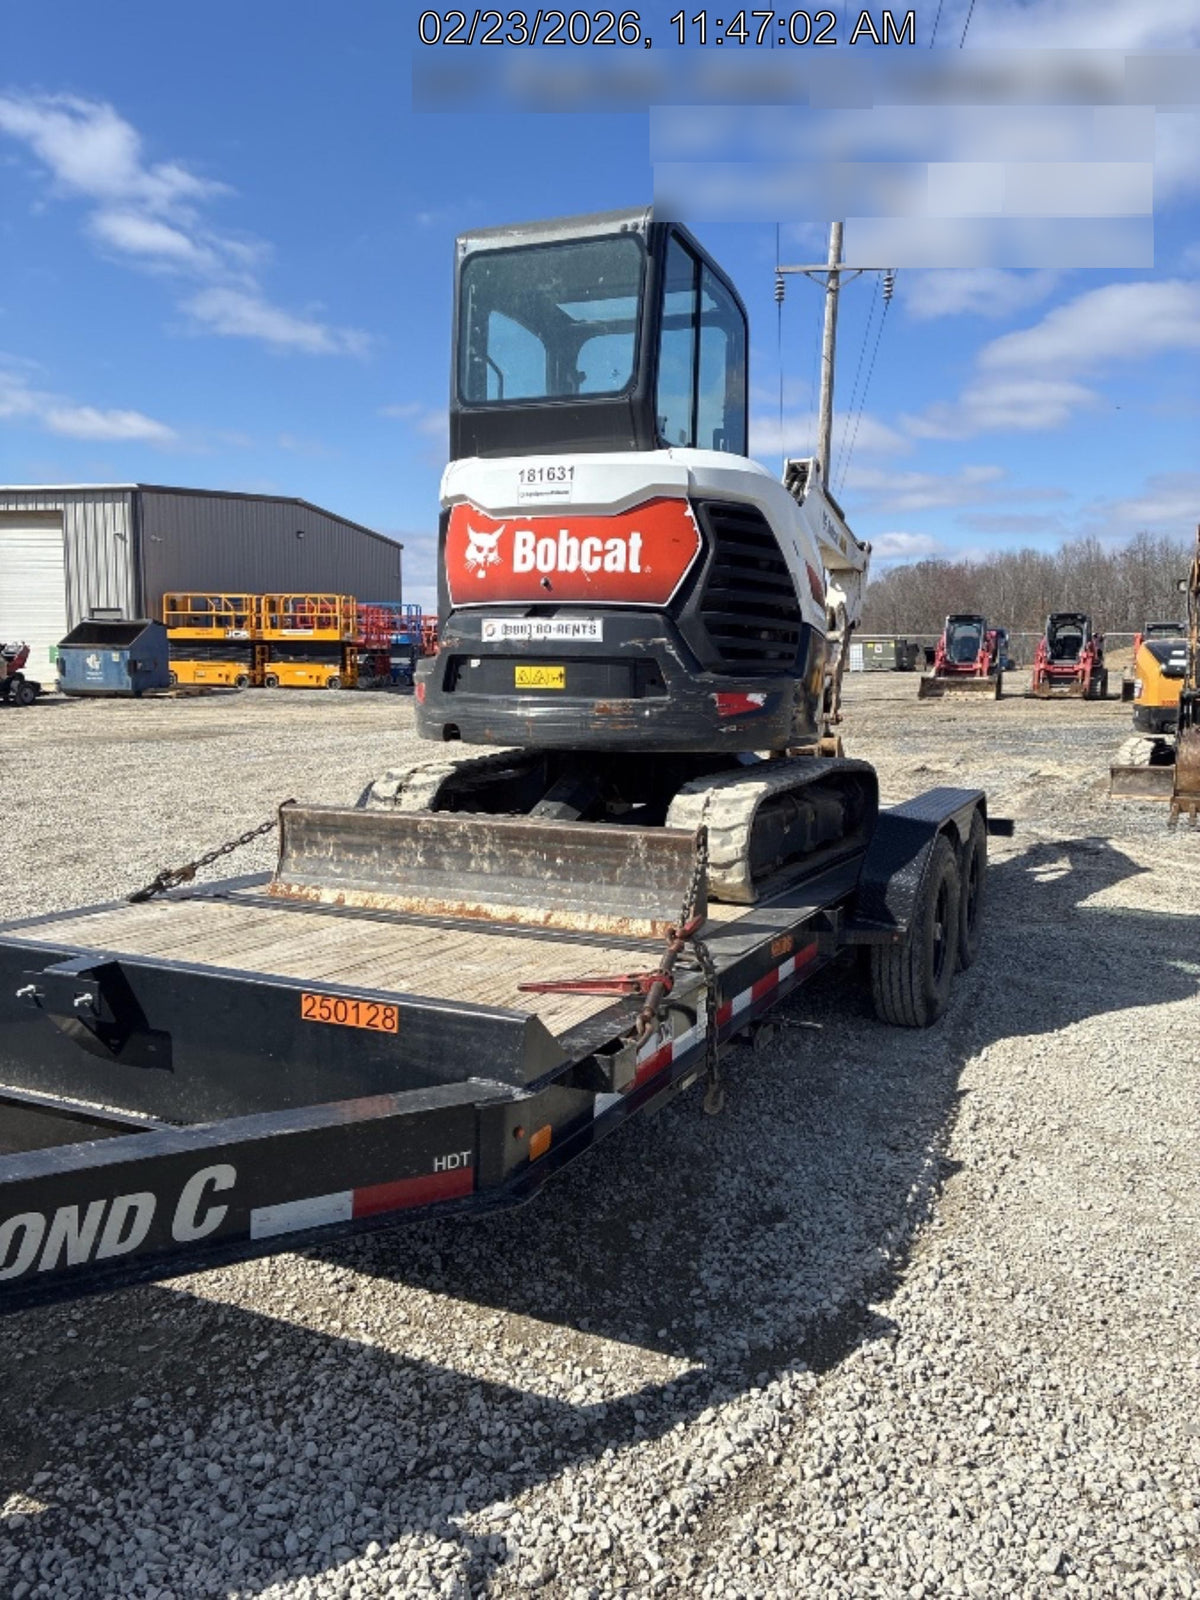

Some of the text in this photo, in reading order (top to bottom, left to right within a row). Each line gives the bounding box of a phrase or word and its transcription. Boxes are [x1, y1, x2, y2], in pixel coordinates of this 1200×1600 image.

[518, 465, 575, 483] 181631
[512, 529, 643, 574] Bobcat
[303, 995, 396, 1031] 250128
[433, 1150, 472, 1172] HDT
[0, 1163, 237, 1281] OND C
